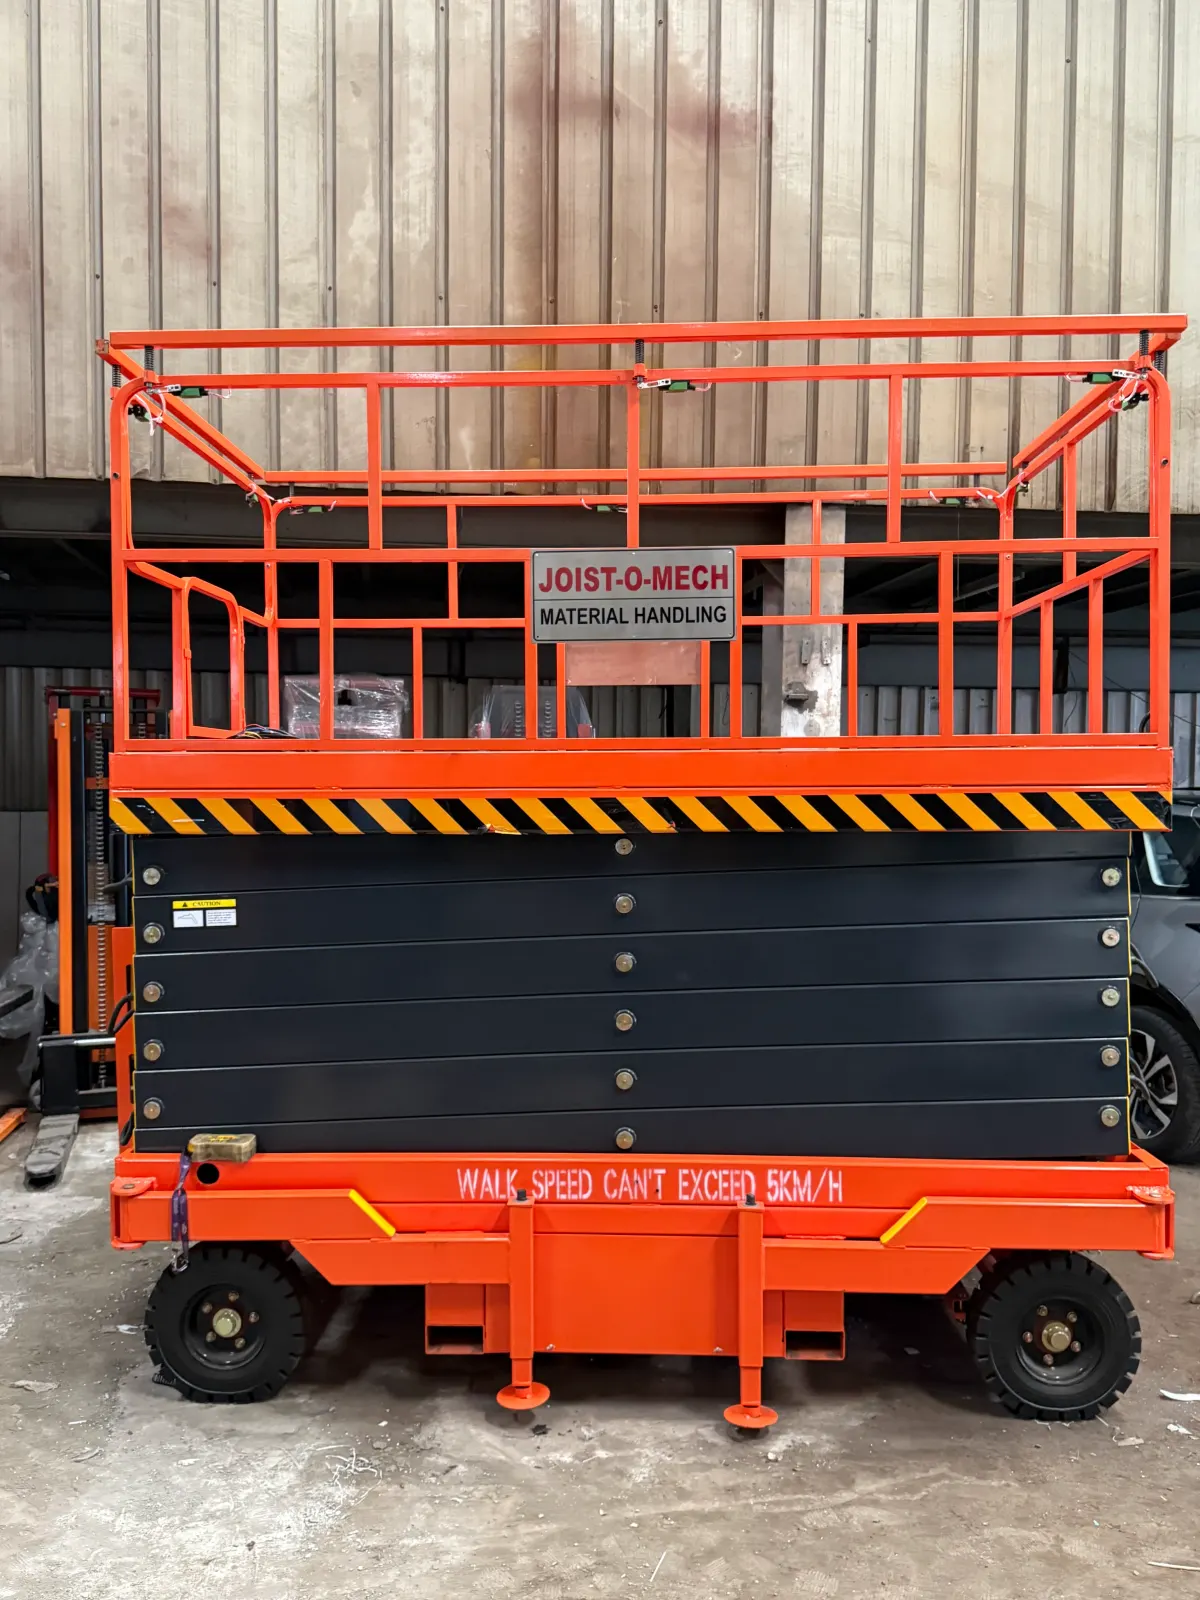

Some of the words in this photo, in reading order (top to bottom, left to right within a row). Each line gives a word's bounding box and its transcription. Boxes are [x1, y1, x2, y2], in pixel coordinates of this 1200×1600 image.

[538, 564, 729, 593] JOIST-O-MECH
[540, 607, 629, 625] MATERIAL
[634, 605, 727, 624] HANDLING
[456, 1168, 519, 1200] WALK
[531, 1168, 593, 1200] SPEED
[603, 1168, 667, 1201] CAN'T
[678, 1168, 757, 1202] EXCEED
[767, 1168, 843, 1203] 5KM/H
